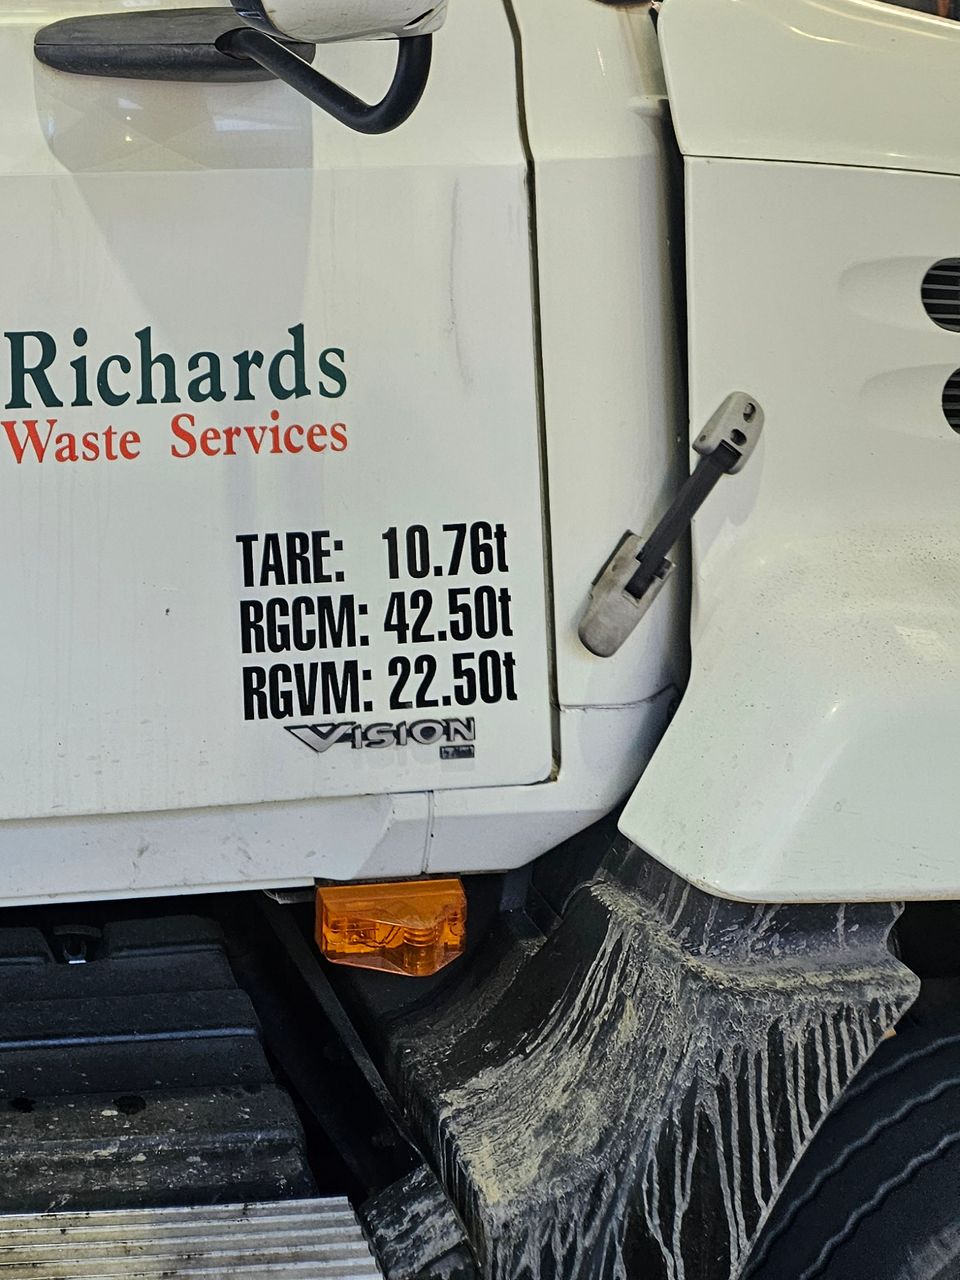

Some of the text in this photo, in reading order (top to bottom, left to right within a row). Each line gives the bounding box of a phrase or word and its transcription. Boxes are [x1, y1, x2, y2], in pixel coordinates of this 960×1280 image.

[4, 323, 347, 409] Richards
[1, 410, 348, 464] Waste Services
[236, 521, 509, 587] TARE: 10.76t
[240, 586, 513, 654] RGCM: 42.50t
[243, 650, 518, 720] RGVM: 22.50t
